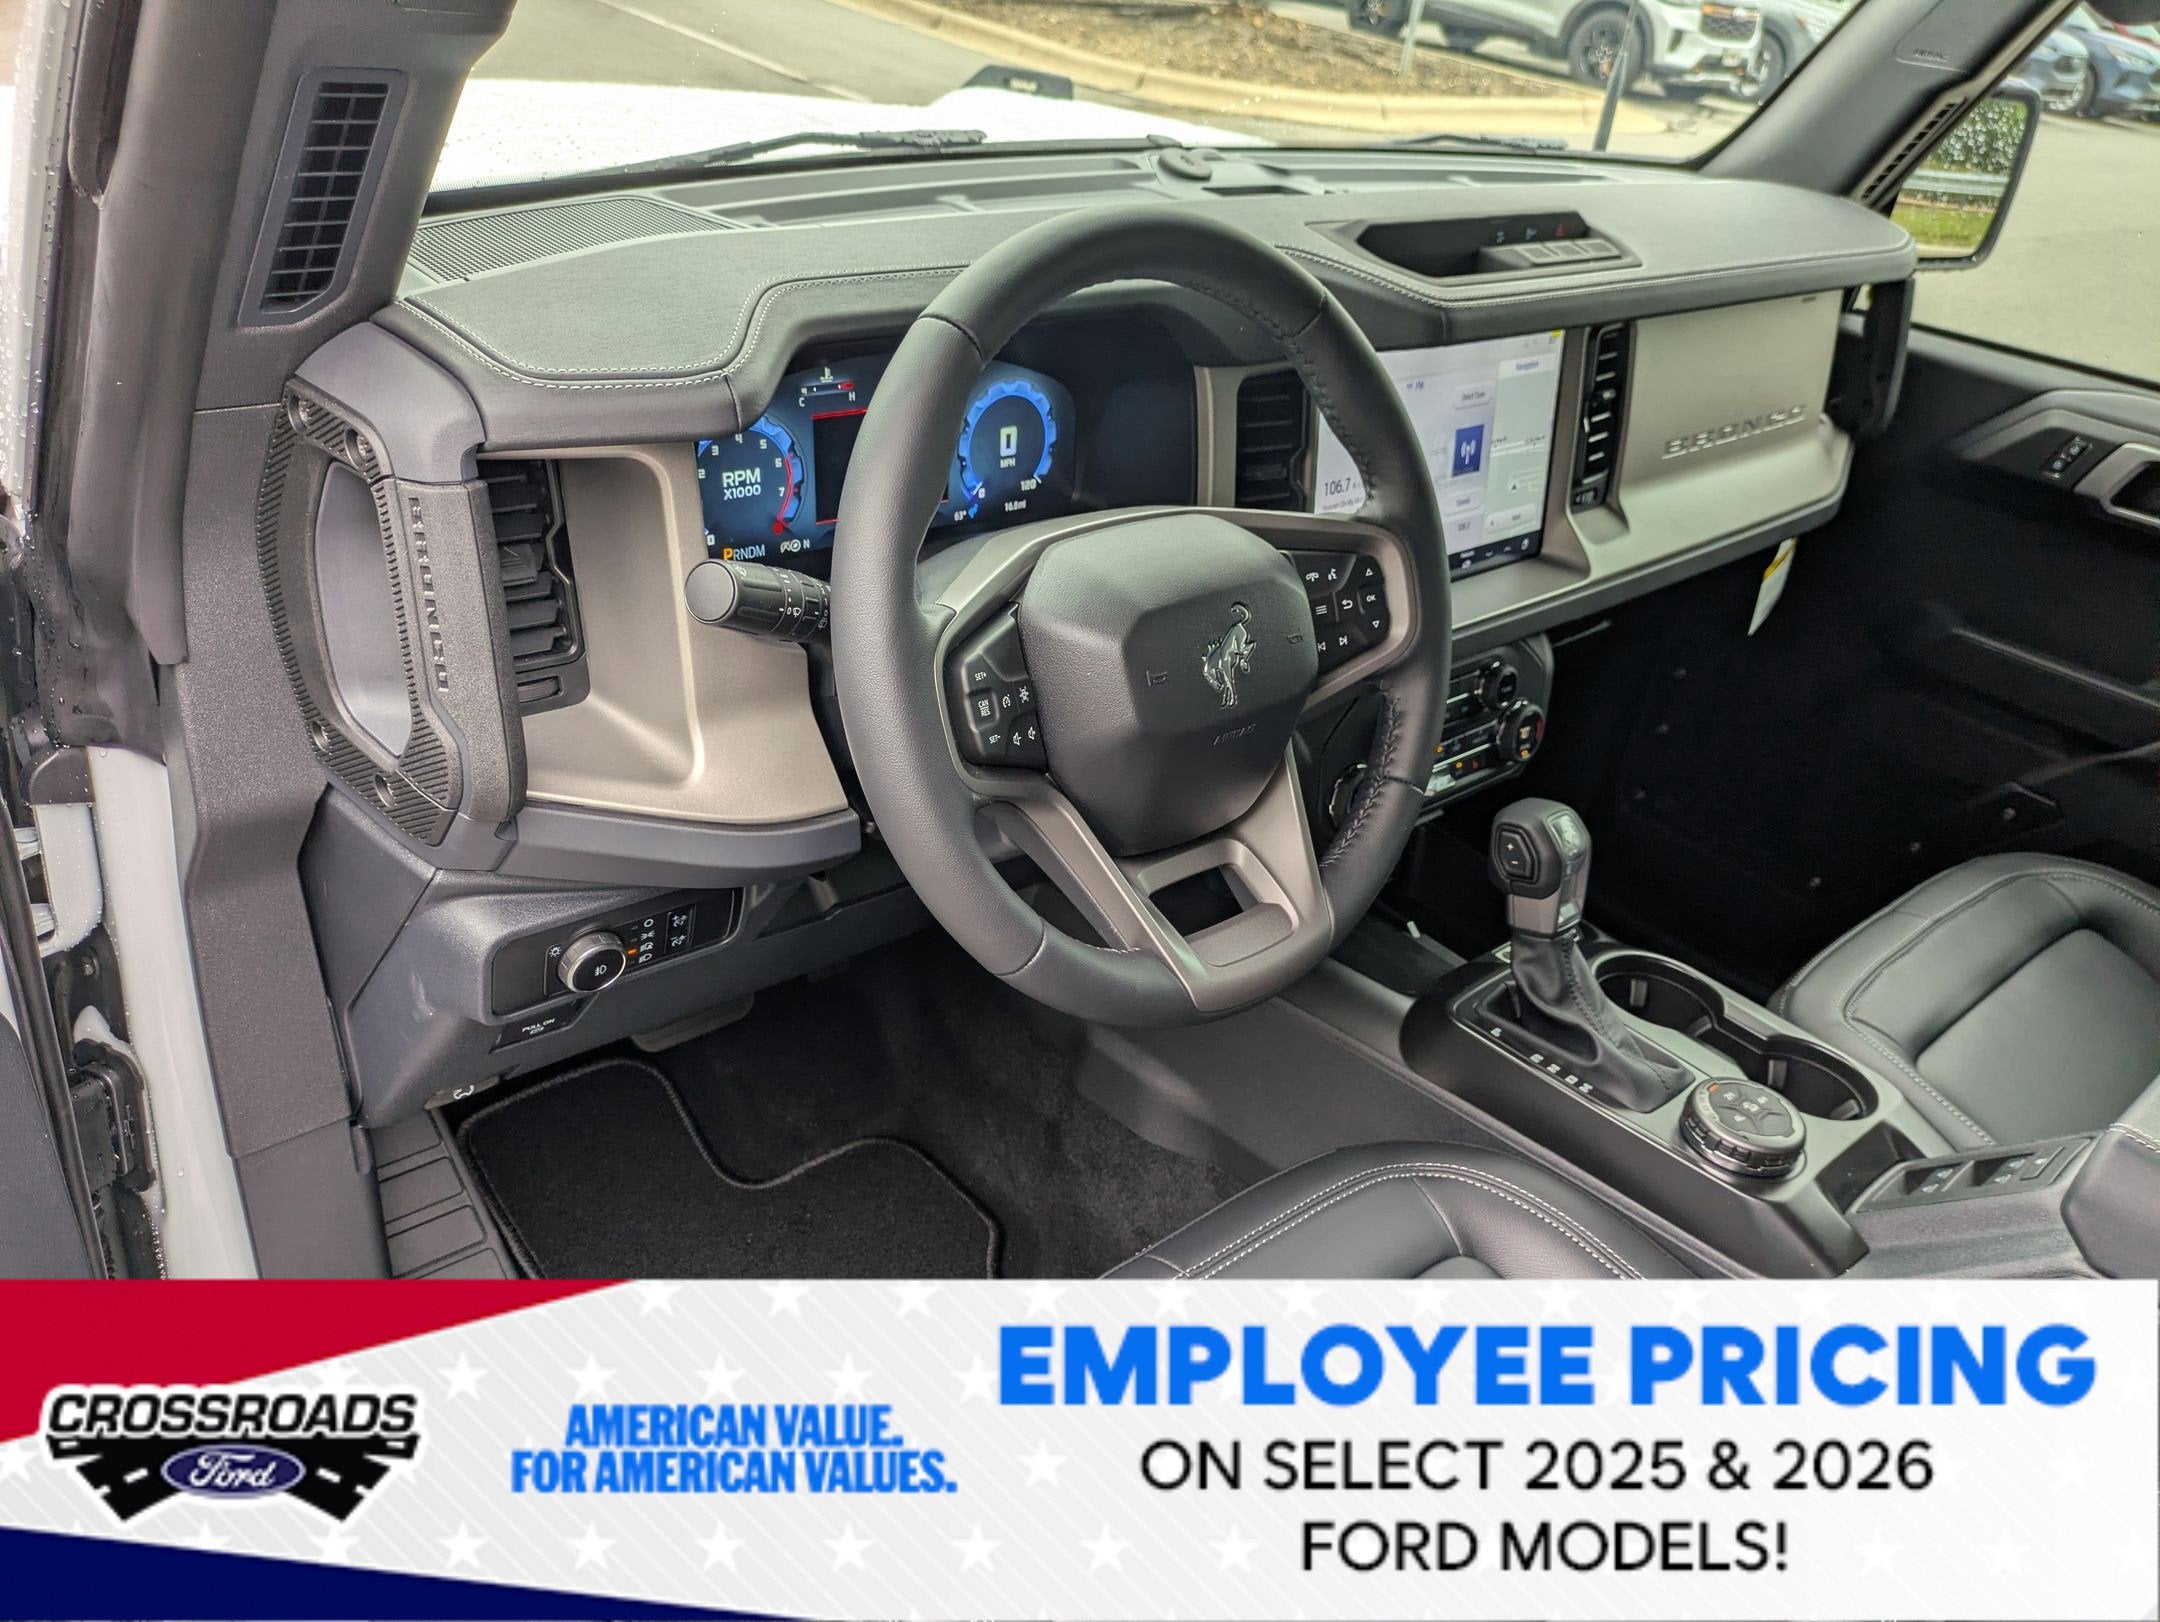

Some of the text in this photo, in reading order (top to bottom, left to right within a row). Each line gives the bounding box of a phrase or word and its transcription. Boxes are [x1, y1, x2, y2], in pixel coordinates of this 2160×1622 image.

[798, 397, 805, 407] C
[849, 391, 856, 402] H
[1661, 404, 1806, 460] BRONCO
[735, 434, 743, 443] 4
[760, 439, 767, 449] 5
[1000, 426, 1018, 457] 0
[711, 445, 719, 456] 3
[775, 458, 782, 468] 6
[1000, 458, 1016, 468] MPH
[698, 469, 706, 479] 2
[722, 467, 762, 488] RPM
[1021, 479, 1037, 491] 120
[1324, 477, 1351, 496] 106.7
[724, 485, 761, 500] X1000
[779, 487, 785, 497] 7
[803, 539, 810, 549] N
[408, 497, 449, 692] BRONCO
